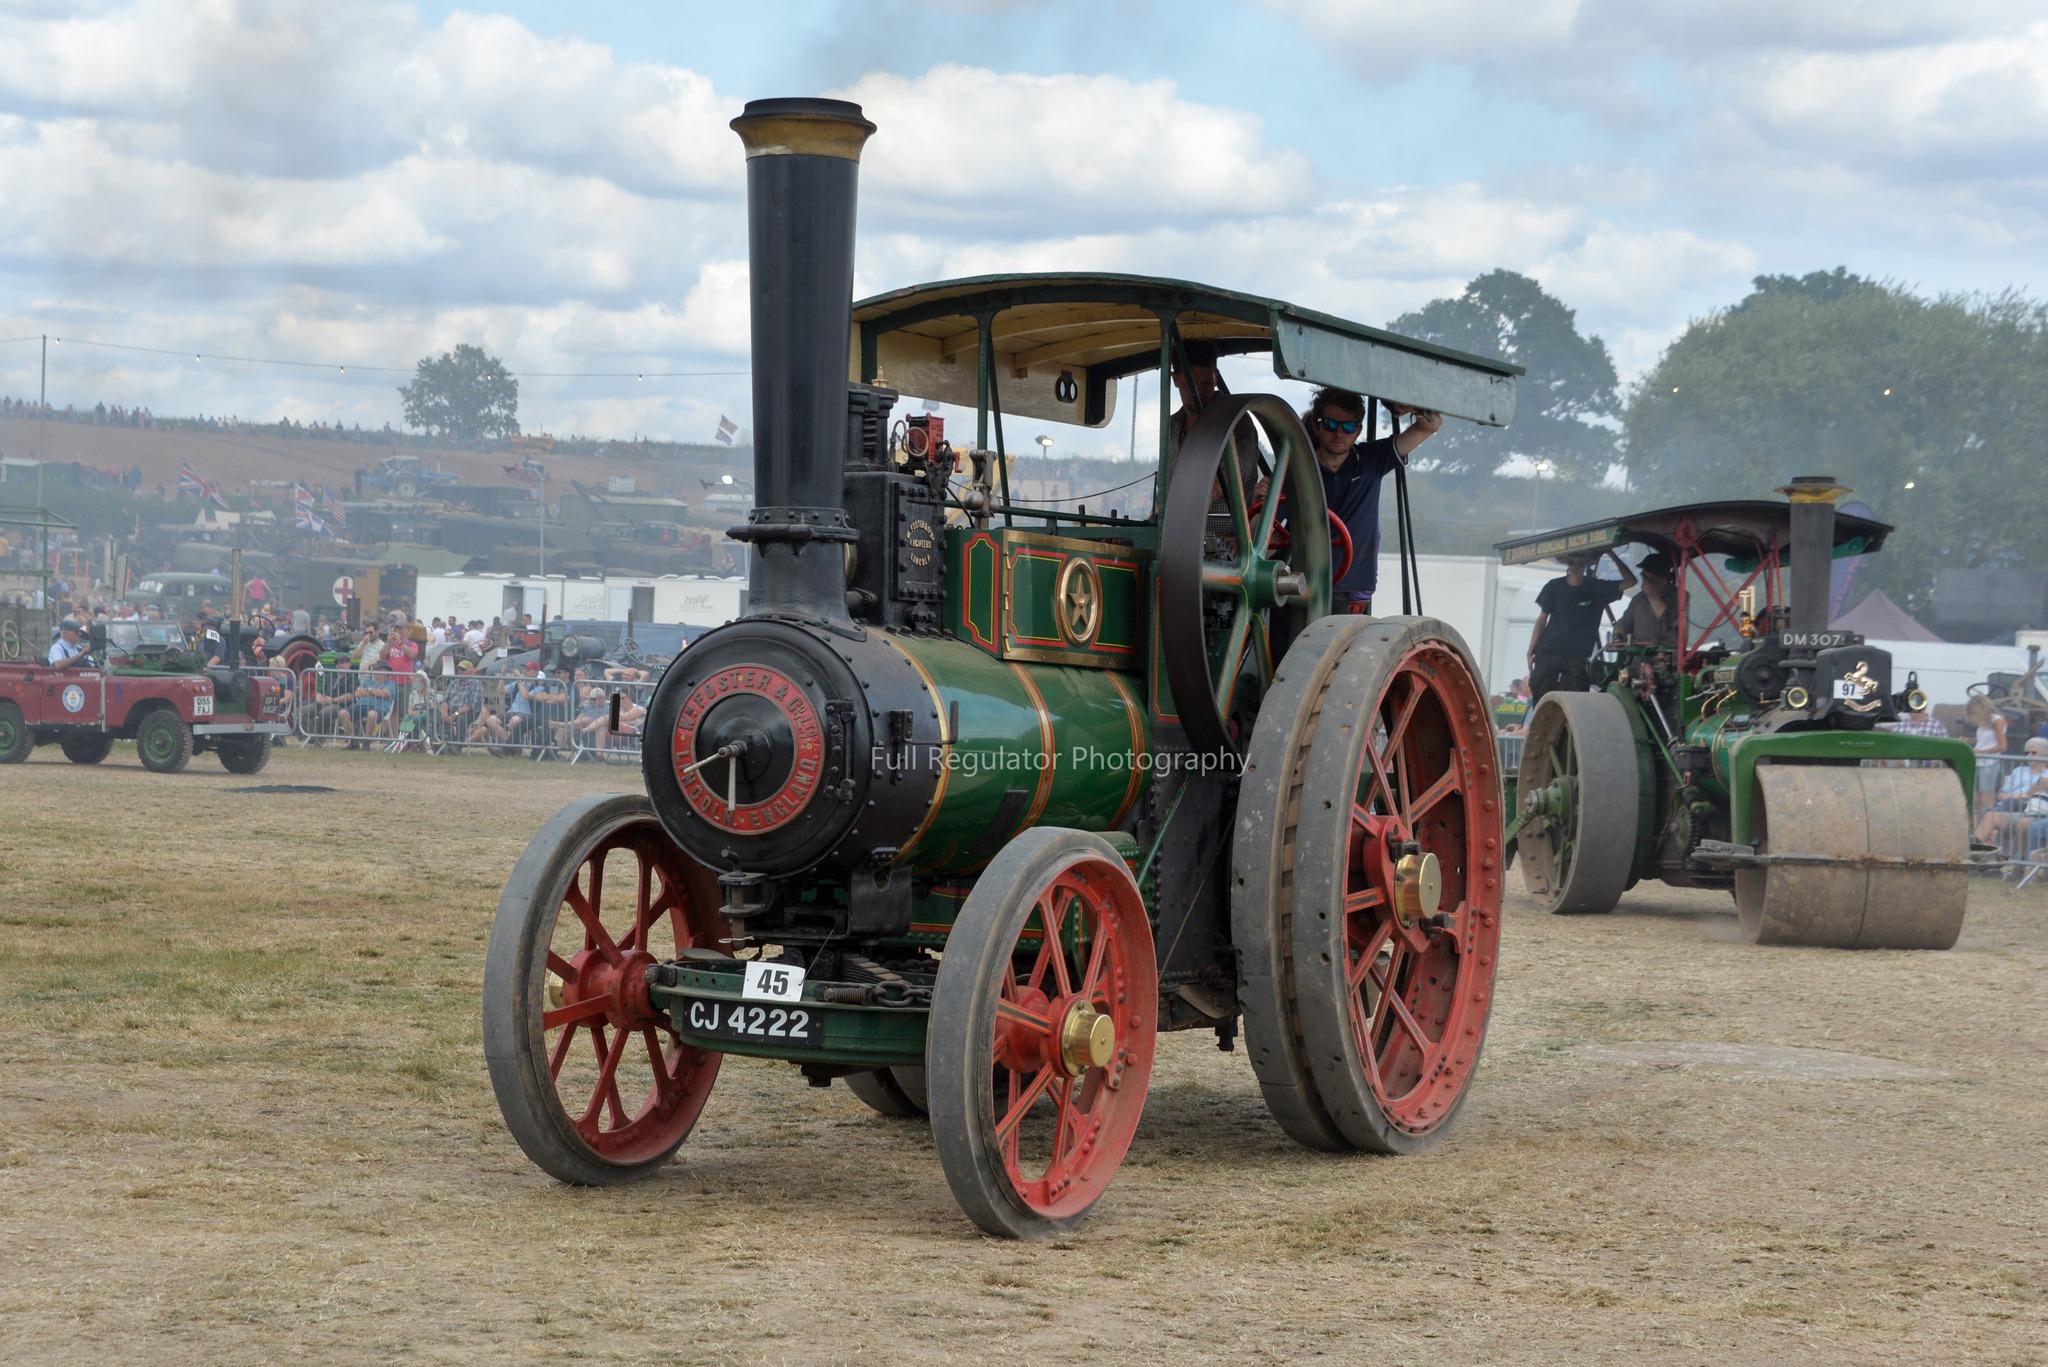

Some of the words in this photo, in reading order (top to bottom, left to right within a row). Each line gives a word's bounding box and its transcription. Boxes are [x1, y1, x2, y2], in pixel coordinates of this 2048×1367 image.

[1783, 633, 1807, 646] DM
[694, 670, 772, 709] FOSTER
[774, 683, 788, 701] &
[1842, 683, 1855, 696] 97
[197, 706, 210, 714] FAJ
[757, 968, 790, 996] 45
[690, 1001, 720, 1031] CJ
[727, 1006, 809, 1038] 4222
